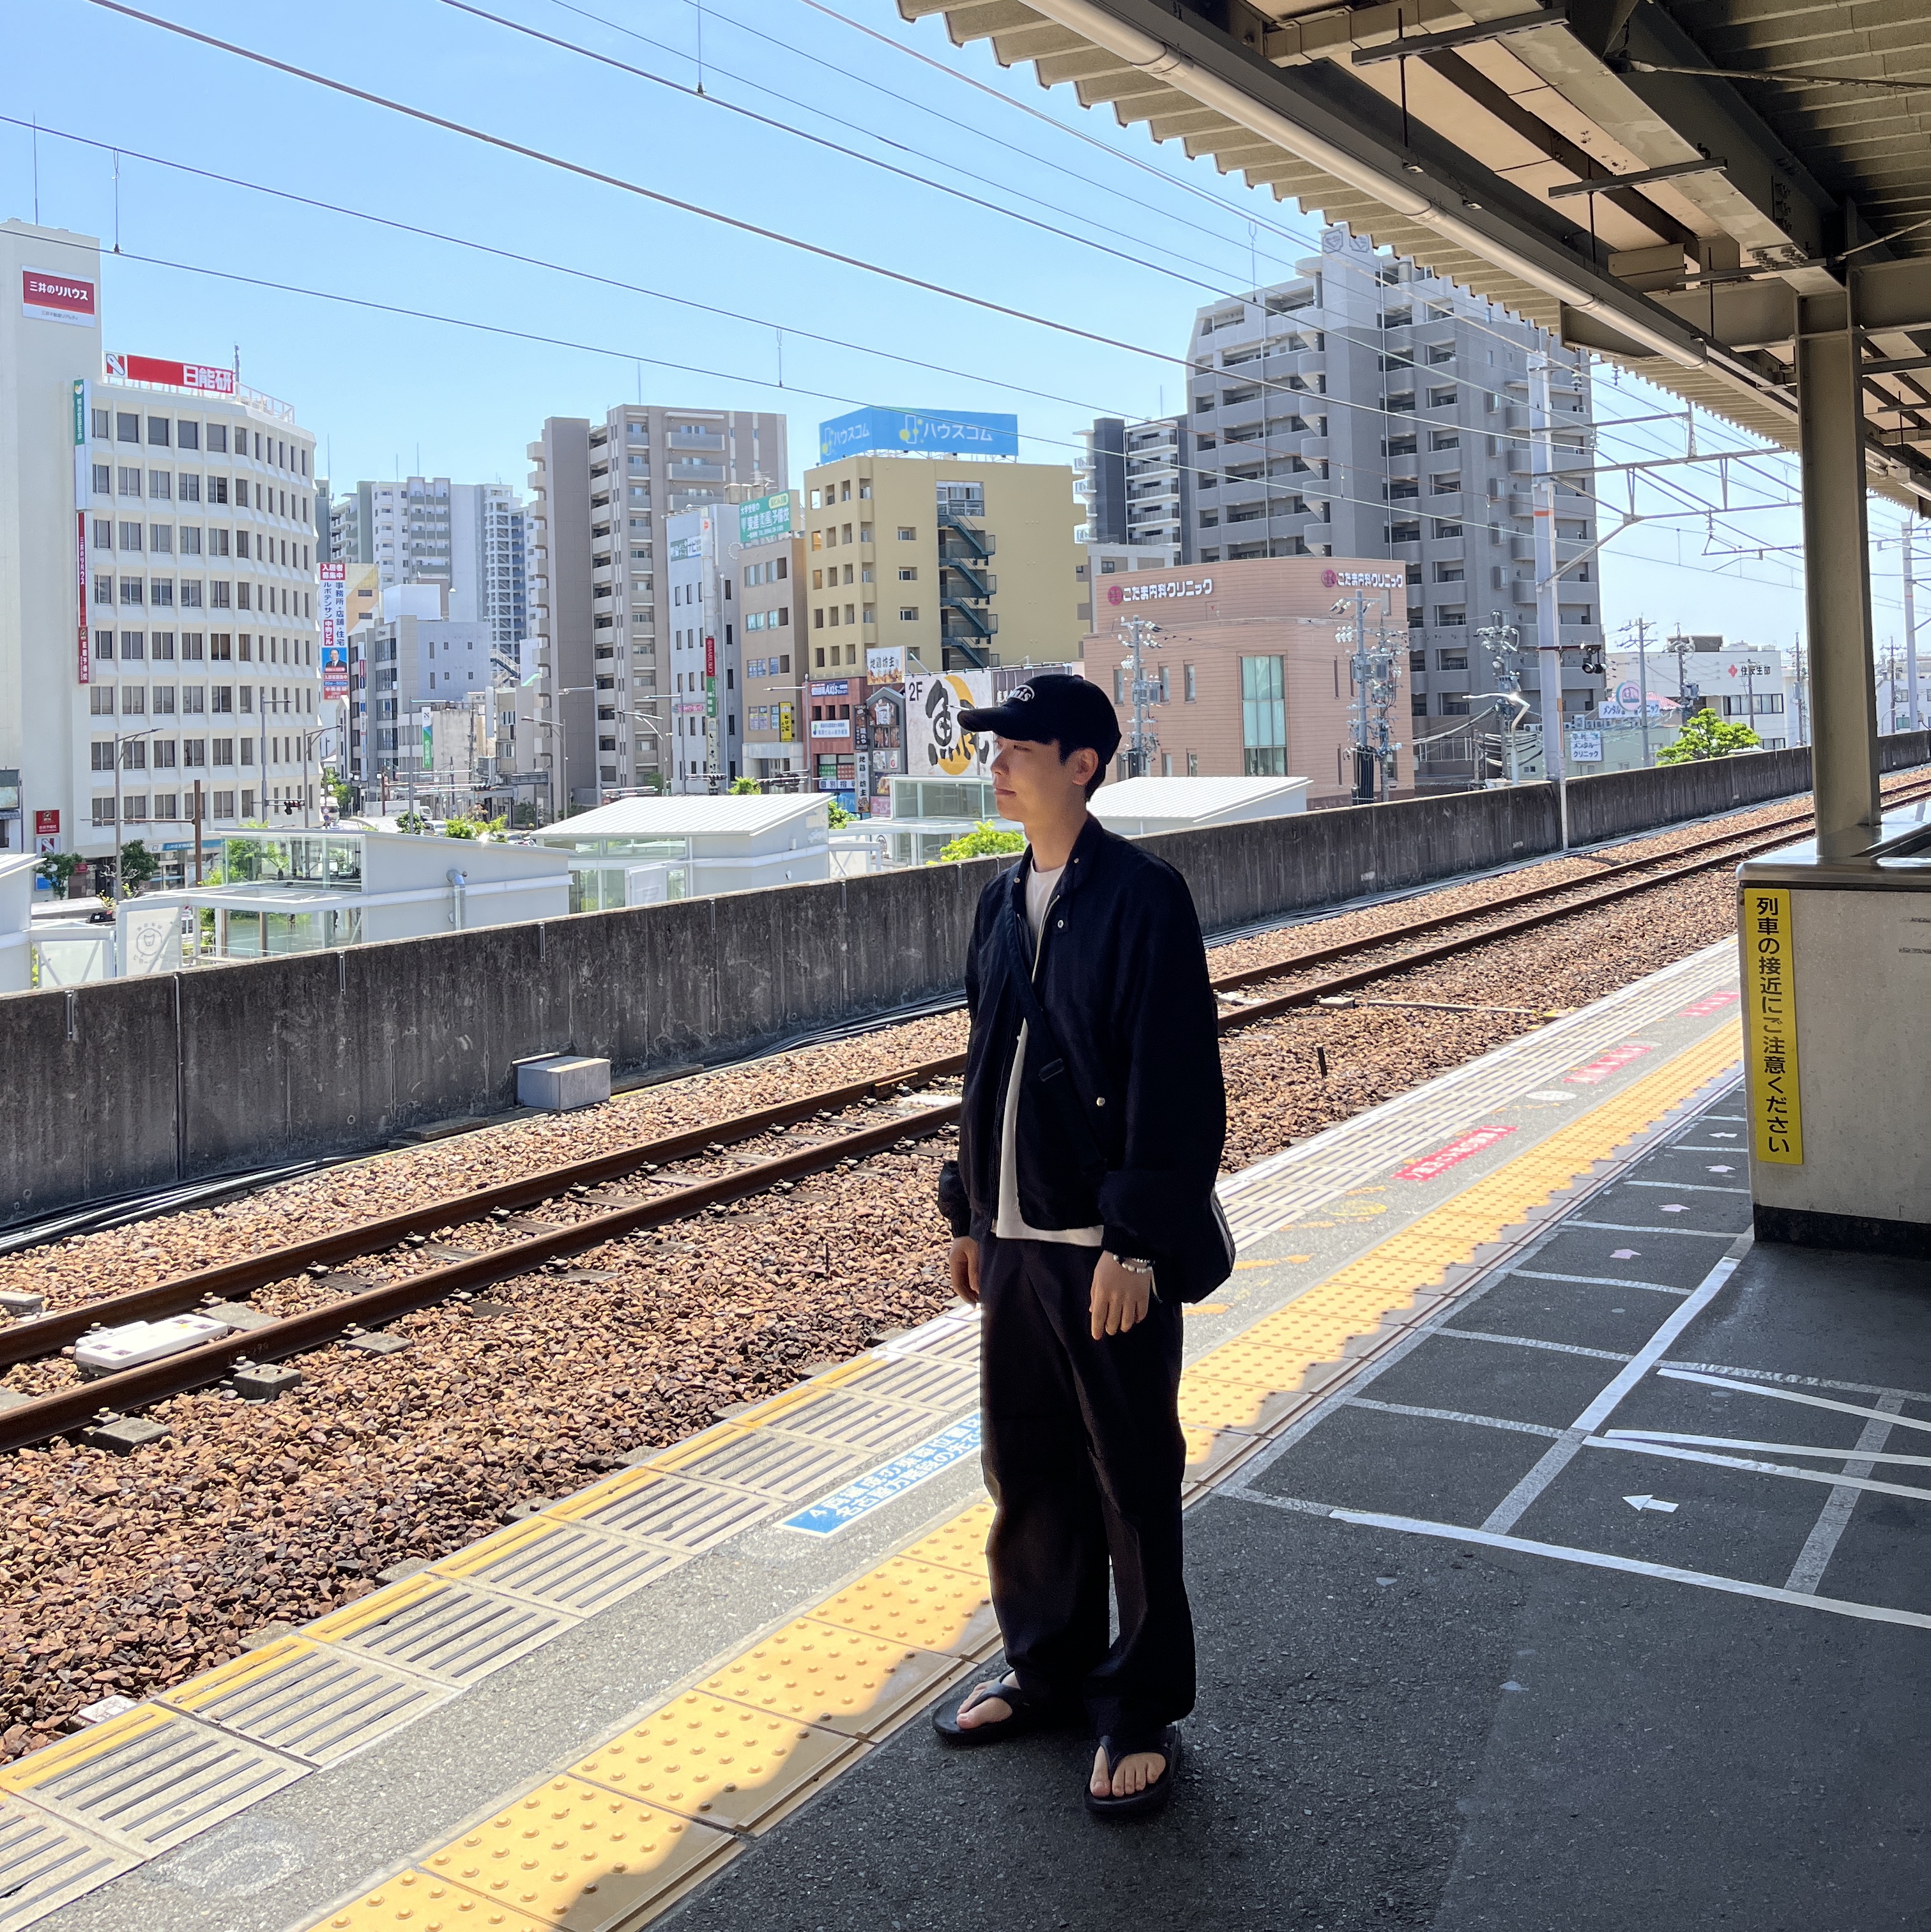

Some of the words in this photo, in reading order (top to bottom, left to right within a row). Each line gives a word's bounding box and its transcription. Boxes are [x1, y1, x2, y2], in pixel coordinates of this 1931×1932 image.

[29, 280, 88, 301] 三井のリハウス
[183, 364, 232, 392] 日能研
[832, 422, 870, 446] ハウスコム
[924, 422, 993, 441] ハウスコム
[322, 564, 343, 572] 入居者
[1337, 572, 1403, 588] こだま内科クリニック
[324, 582, 332, 619] ルポテンサン
[1122, 578, 1212, 602] こだま内科クリニック
[335, 582, 345, 647] 事務所・店舗・住宅
[908, 681, 923, 702] 2F
[1755, 896, 1790, 1153] 列車の接近にご注意ください
[836, 1429, 981, 1517] 名古屋方階段の先で
